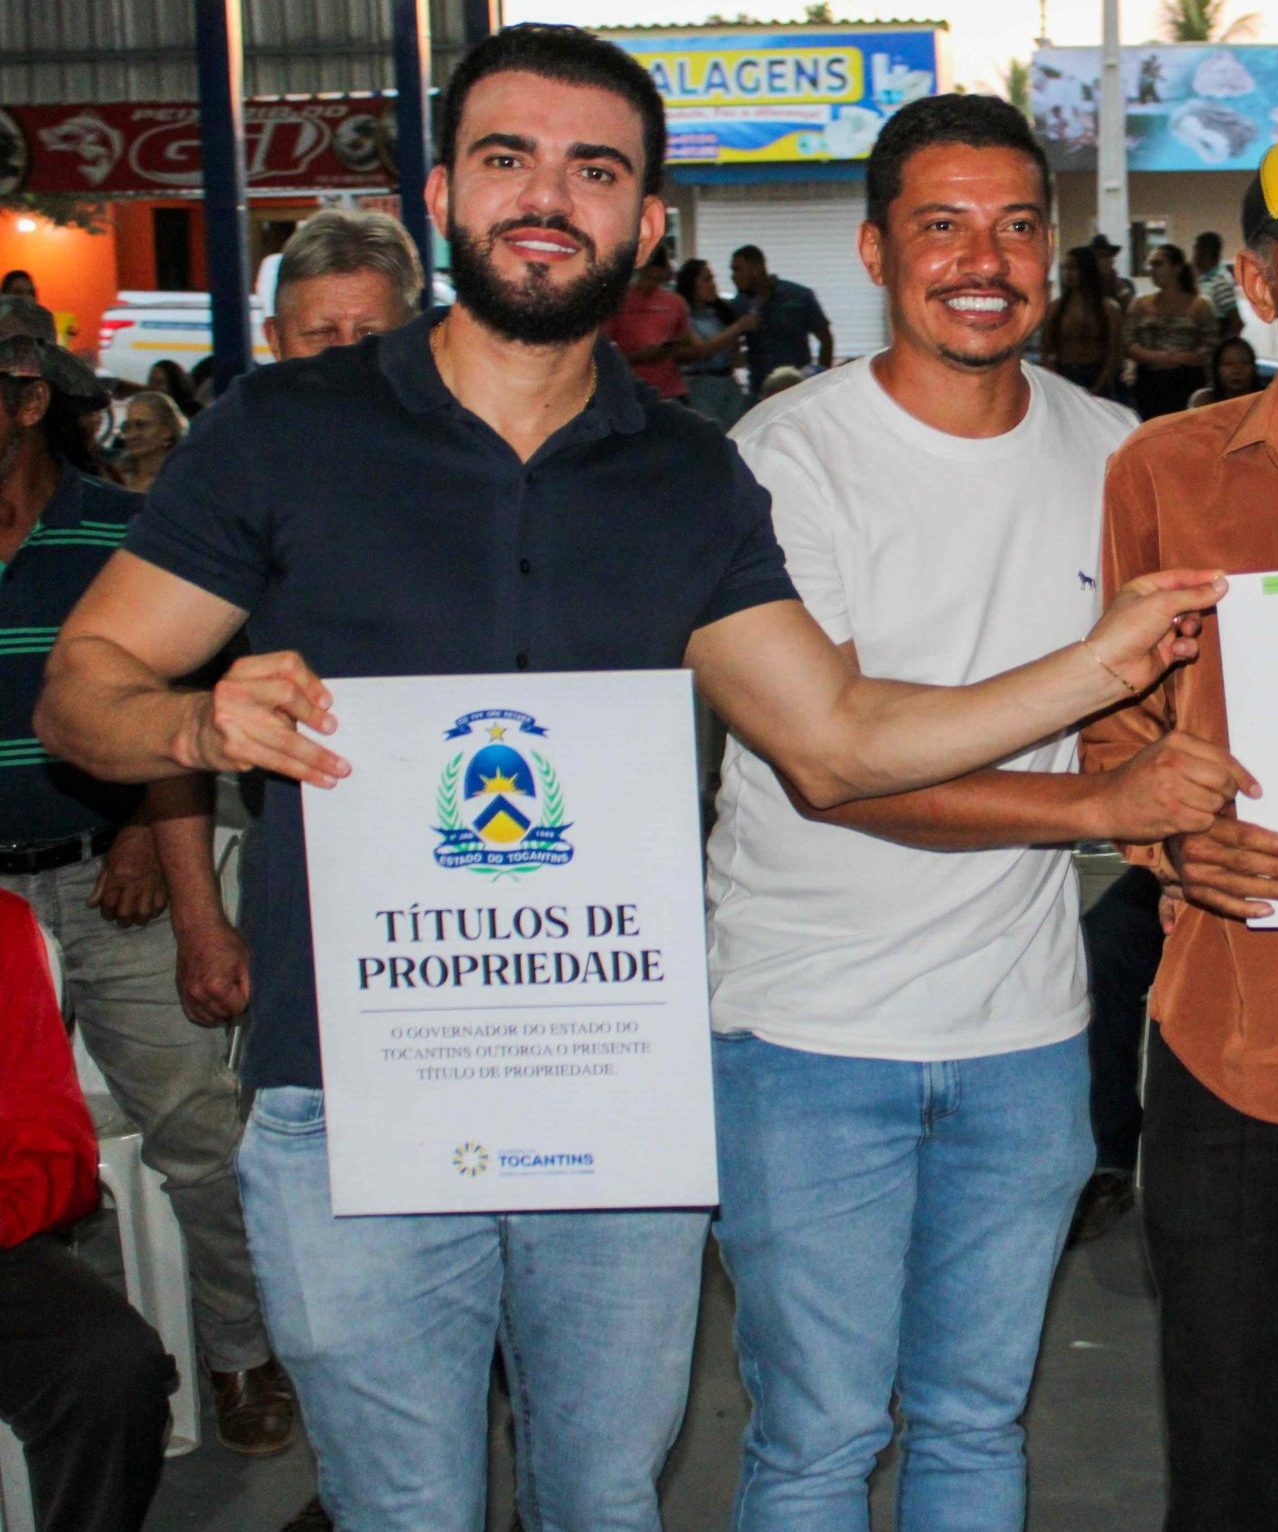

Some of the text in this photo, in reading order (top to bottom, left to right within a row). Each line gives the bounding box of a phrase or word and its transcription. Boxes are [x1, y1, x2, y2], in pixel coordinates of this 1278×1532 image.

[439, 852, 569, 866] ESTADO DO TOCANTINS
[375, 903, 641, 943] TÍTULOS DE
[357, 949, 665, 990] PROPRIEDADE
[391, 1021, 639, 1040] O GOVERNADOR DO ESTADO DO
[381, 1041, 651, 1061] TOCANTINS OUTORGA O PRESENTE
[416, 1065, 475, 1081] TÍTULO
[479, 1066, 500, 1079] DE
[498, 1152, 595, 1168] TOCANTINS
